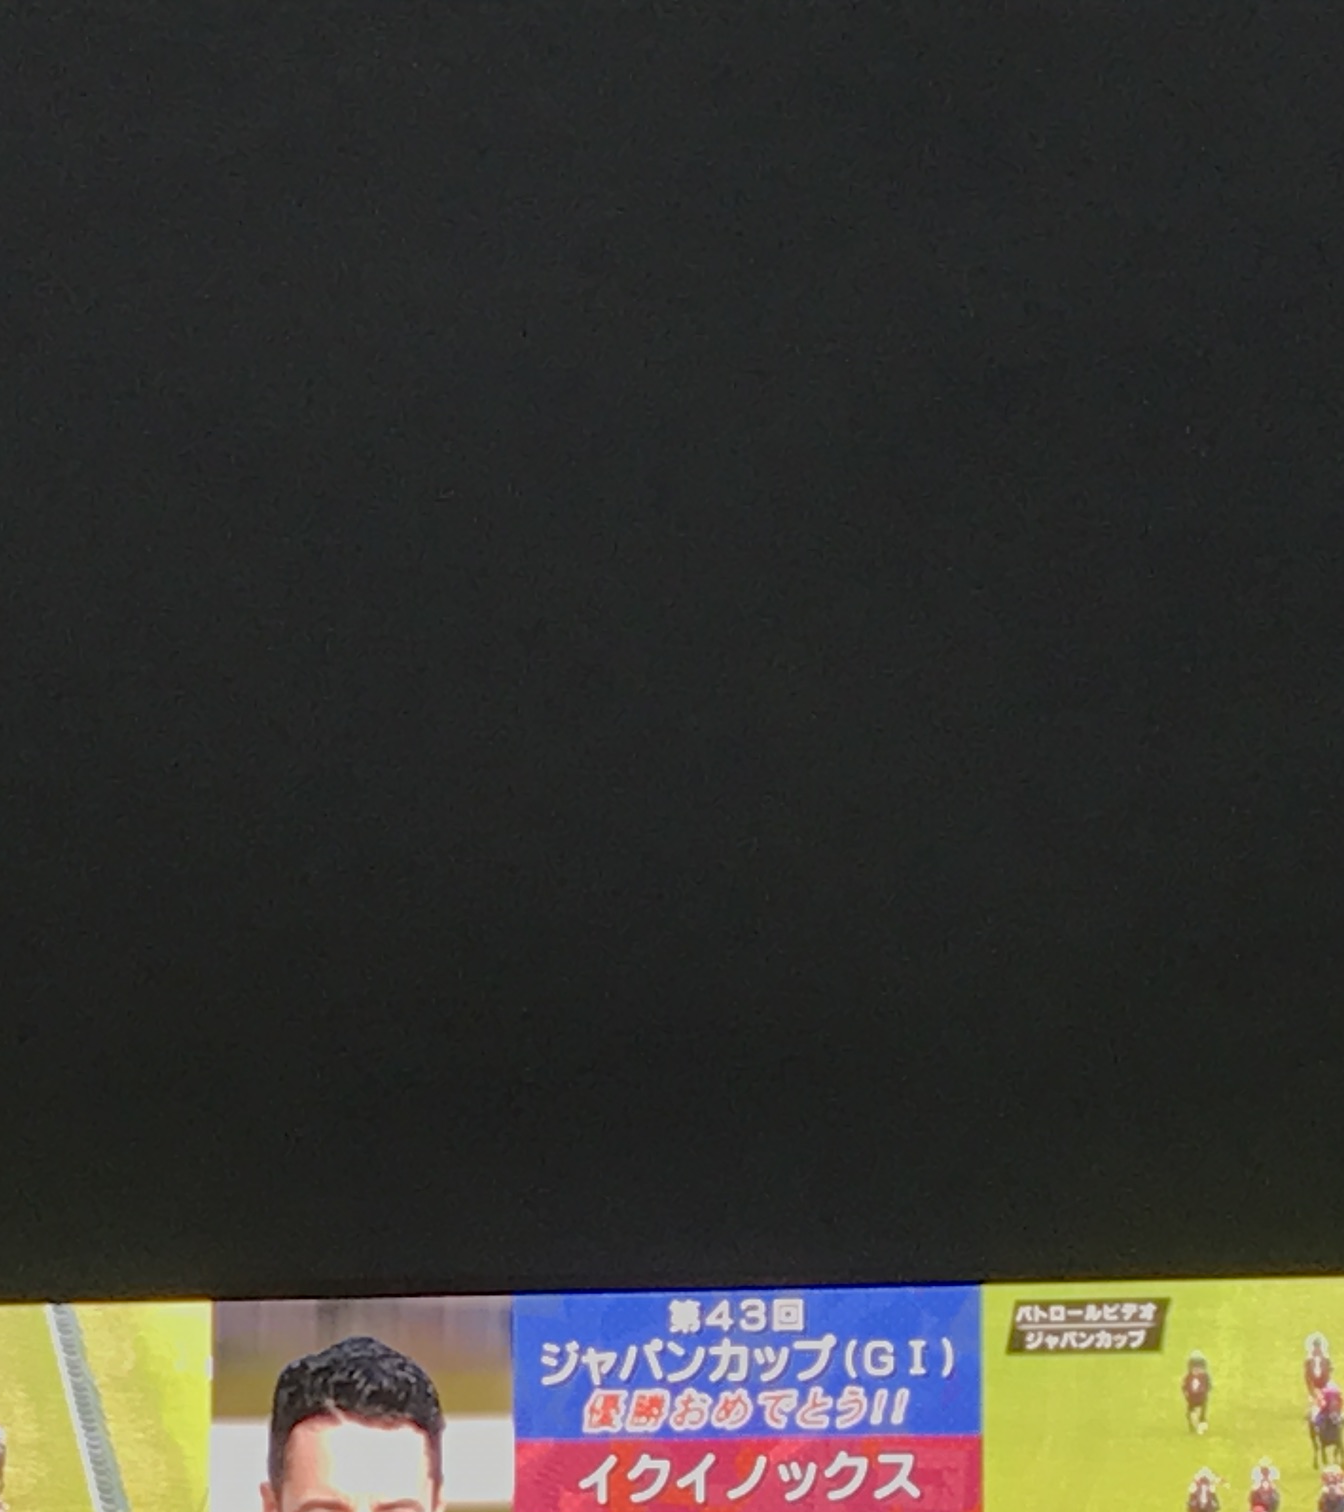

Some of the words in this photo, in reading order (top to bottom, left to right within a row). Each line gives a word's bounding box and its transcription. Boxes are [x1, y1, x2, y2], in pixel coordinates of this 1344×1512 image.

[668, 1298, 805, 1333] 第43回
[1016, 1303, 1158, 1322] パトロールビデオ
[1025, 1329, 1146, 1349] ジャパンカップ
[582, 1387, 910, 1433] 優勝おめでとう!!
[579, 1451, 921, 1504] イクイノックス
